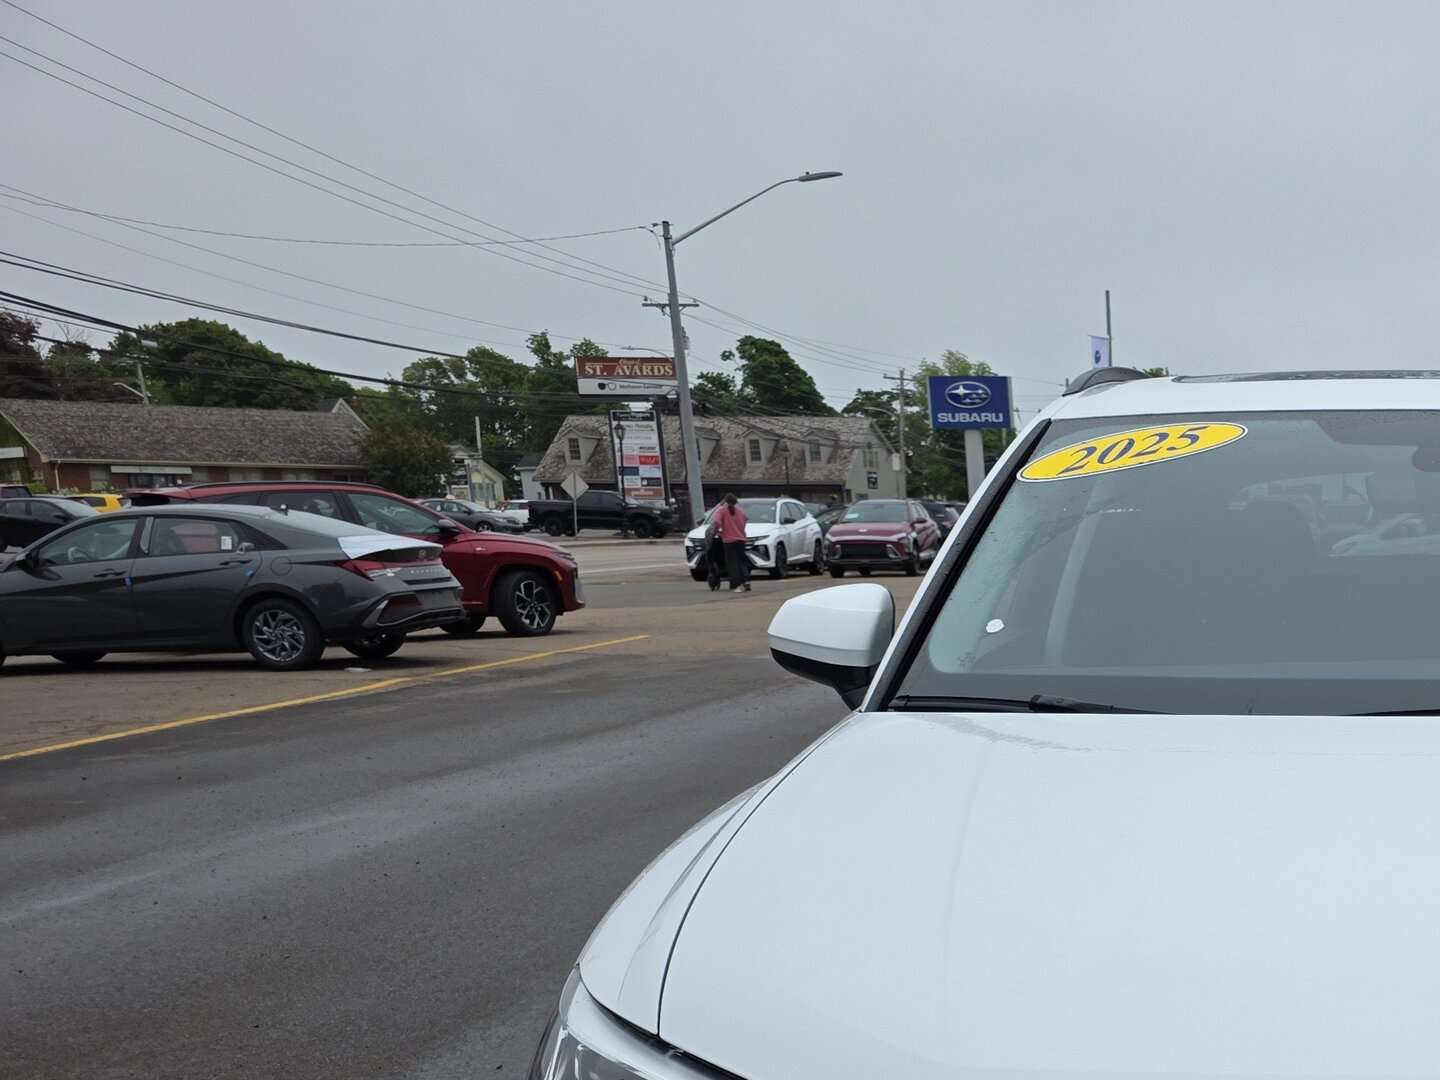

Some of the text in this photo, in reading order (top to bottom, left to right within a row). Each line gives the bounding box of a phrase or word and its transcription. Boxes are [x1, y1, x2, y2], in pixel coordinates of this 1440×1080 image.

[585, 365, 673, 376] ST. AVARDS
[936, 412, 1004, 423] SUBARU
[1055, 425, 1209, 476] 2025
